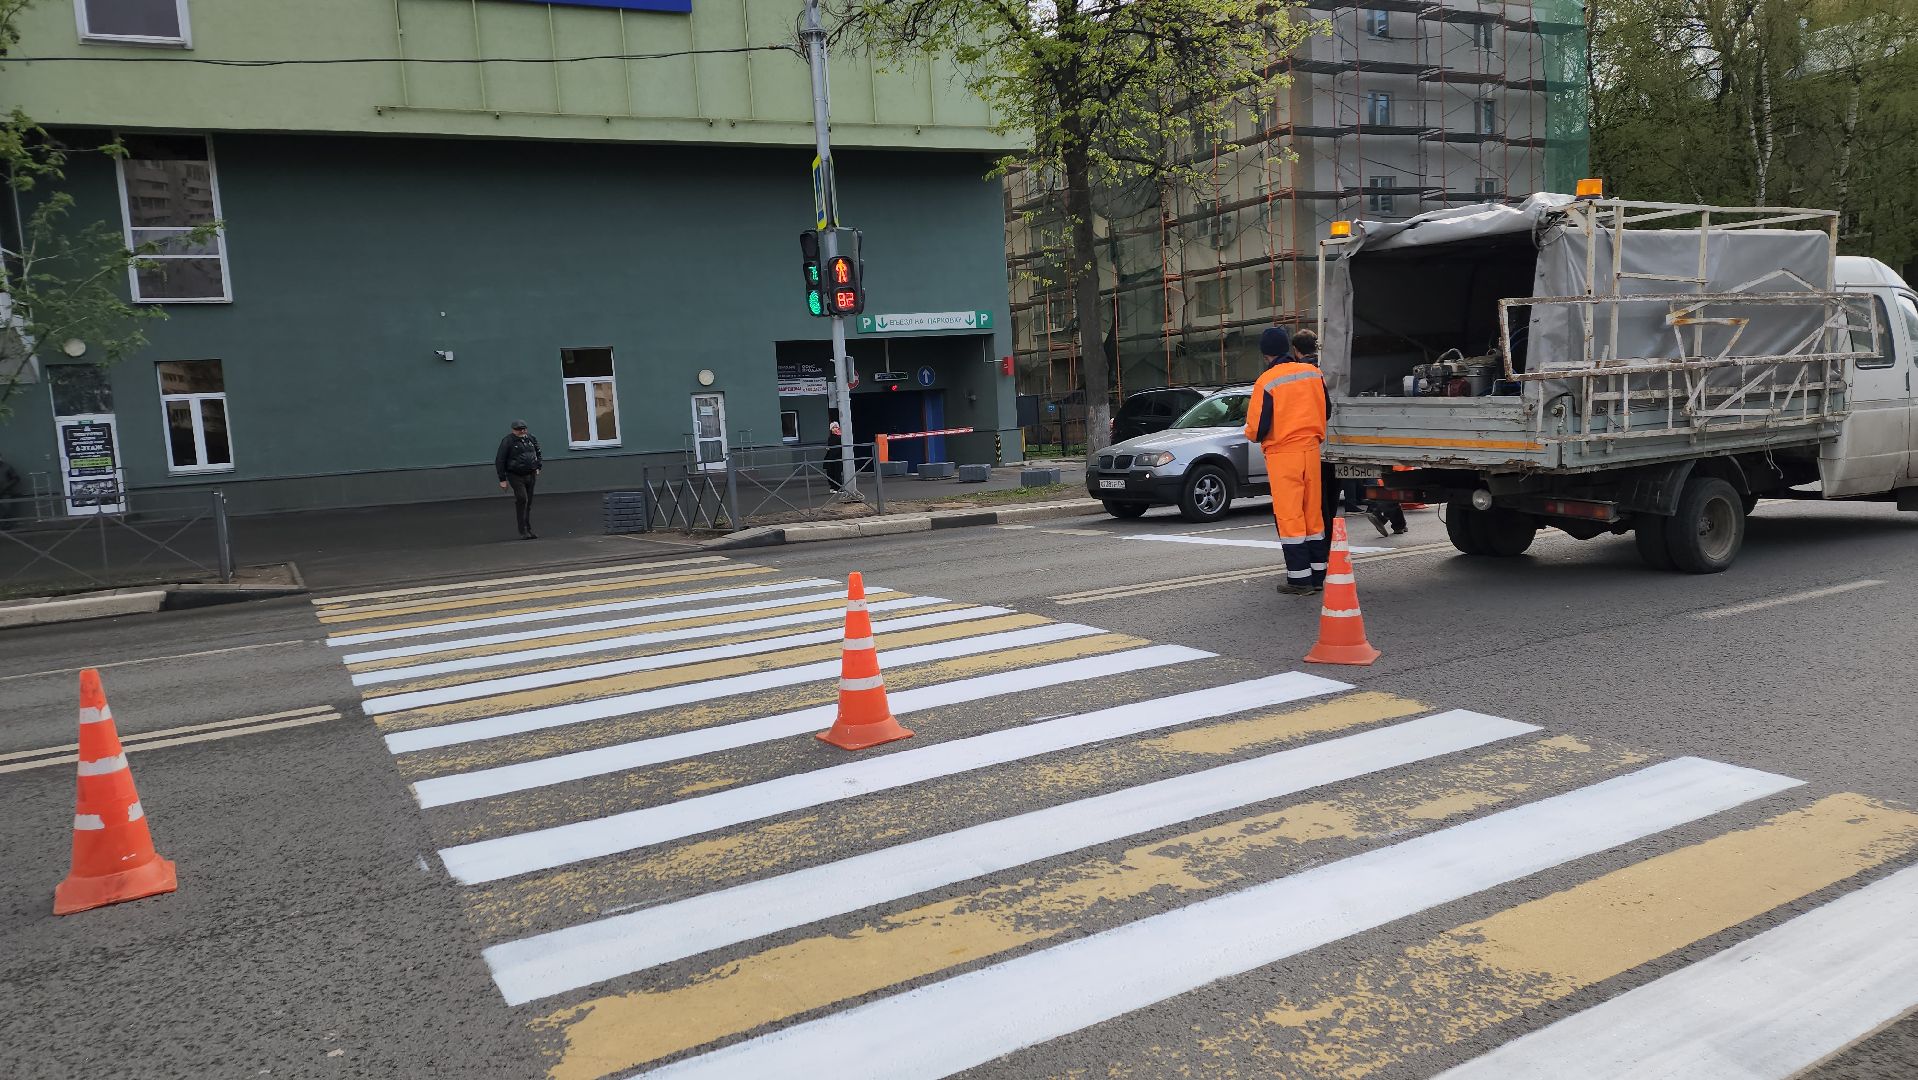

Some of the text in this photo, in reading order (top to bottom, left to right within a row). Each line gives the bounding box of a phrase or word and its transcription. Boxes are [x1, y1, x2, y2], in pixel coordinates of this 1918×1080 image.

[837, 292, 854, 308] 82
[863, 317, 872, 329] P
[980, 313, 989, 325] P
